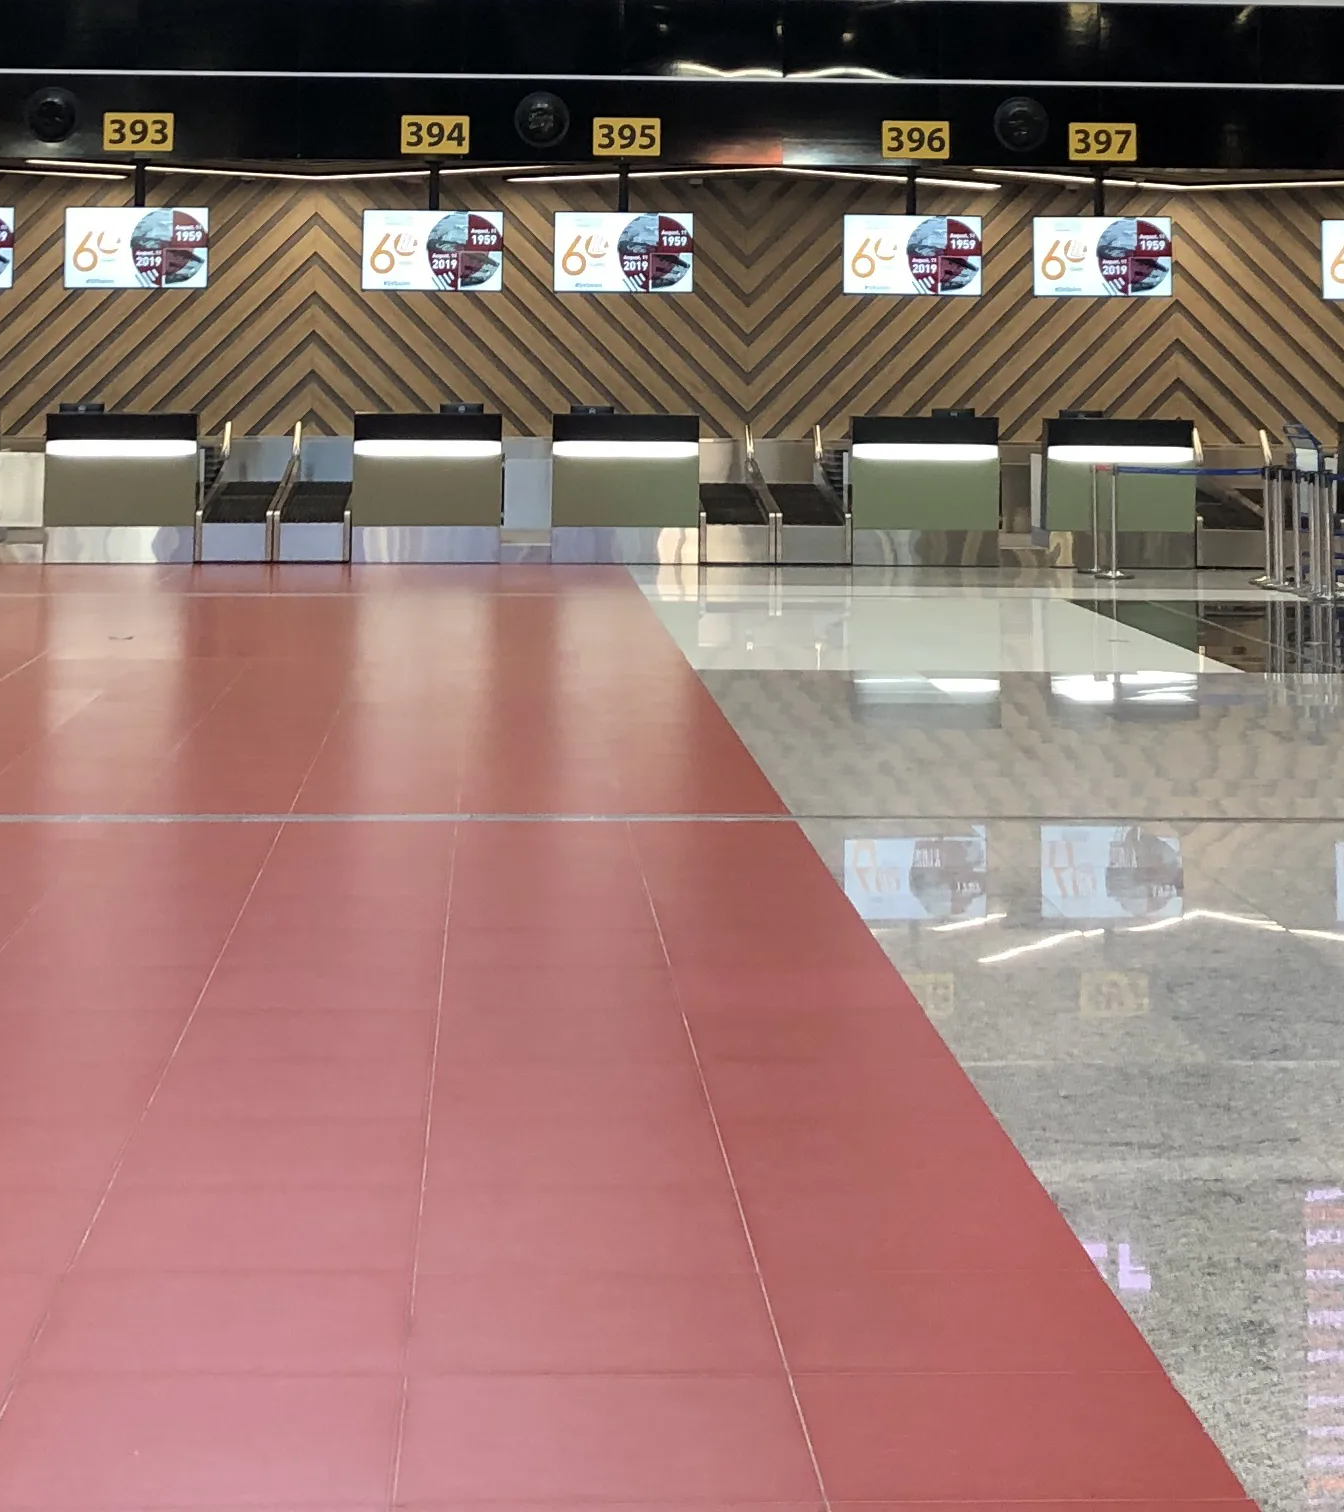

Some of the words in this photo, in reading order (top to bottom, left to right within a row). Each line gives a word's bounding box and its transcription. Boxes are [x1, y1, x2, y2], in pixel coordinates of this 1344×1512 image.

[108, 119, 169, 145] 393
[405, 122, 466, 148] 394
[597, 123, 656, 150] 395
[886, 127, 946, 153] 396
[1073, 129, 1132, 155] 397
[471, 235, 497, 245] 1959
[1139, 239, 1166, 251] 1959
[432, 259, 457, 269] 2019
[1102, 263, 1128, 276] 2019
